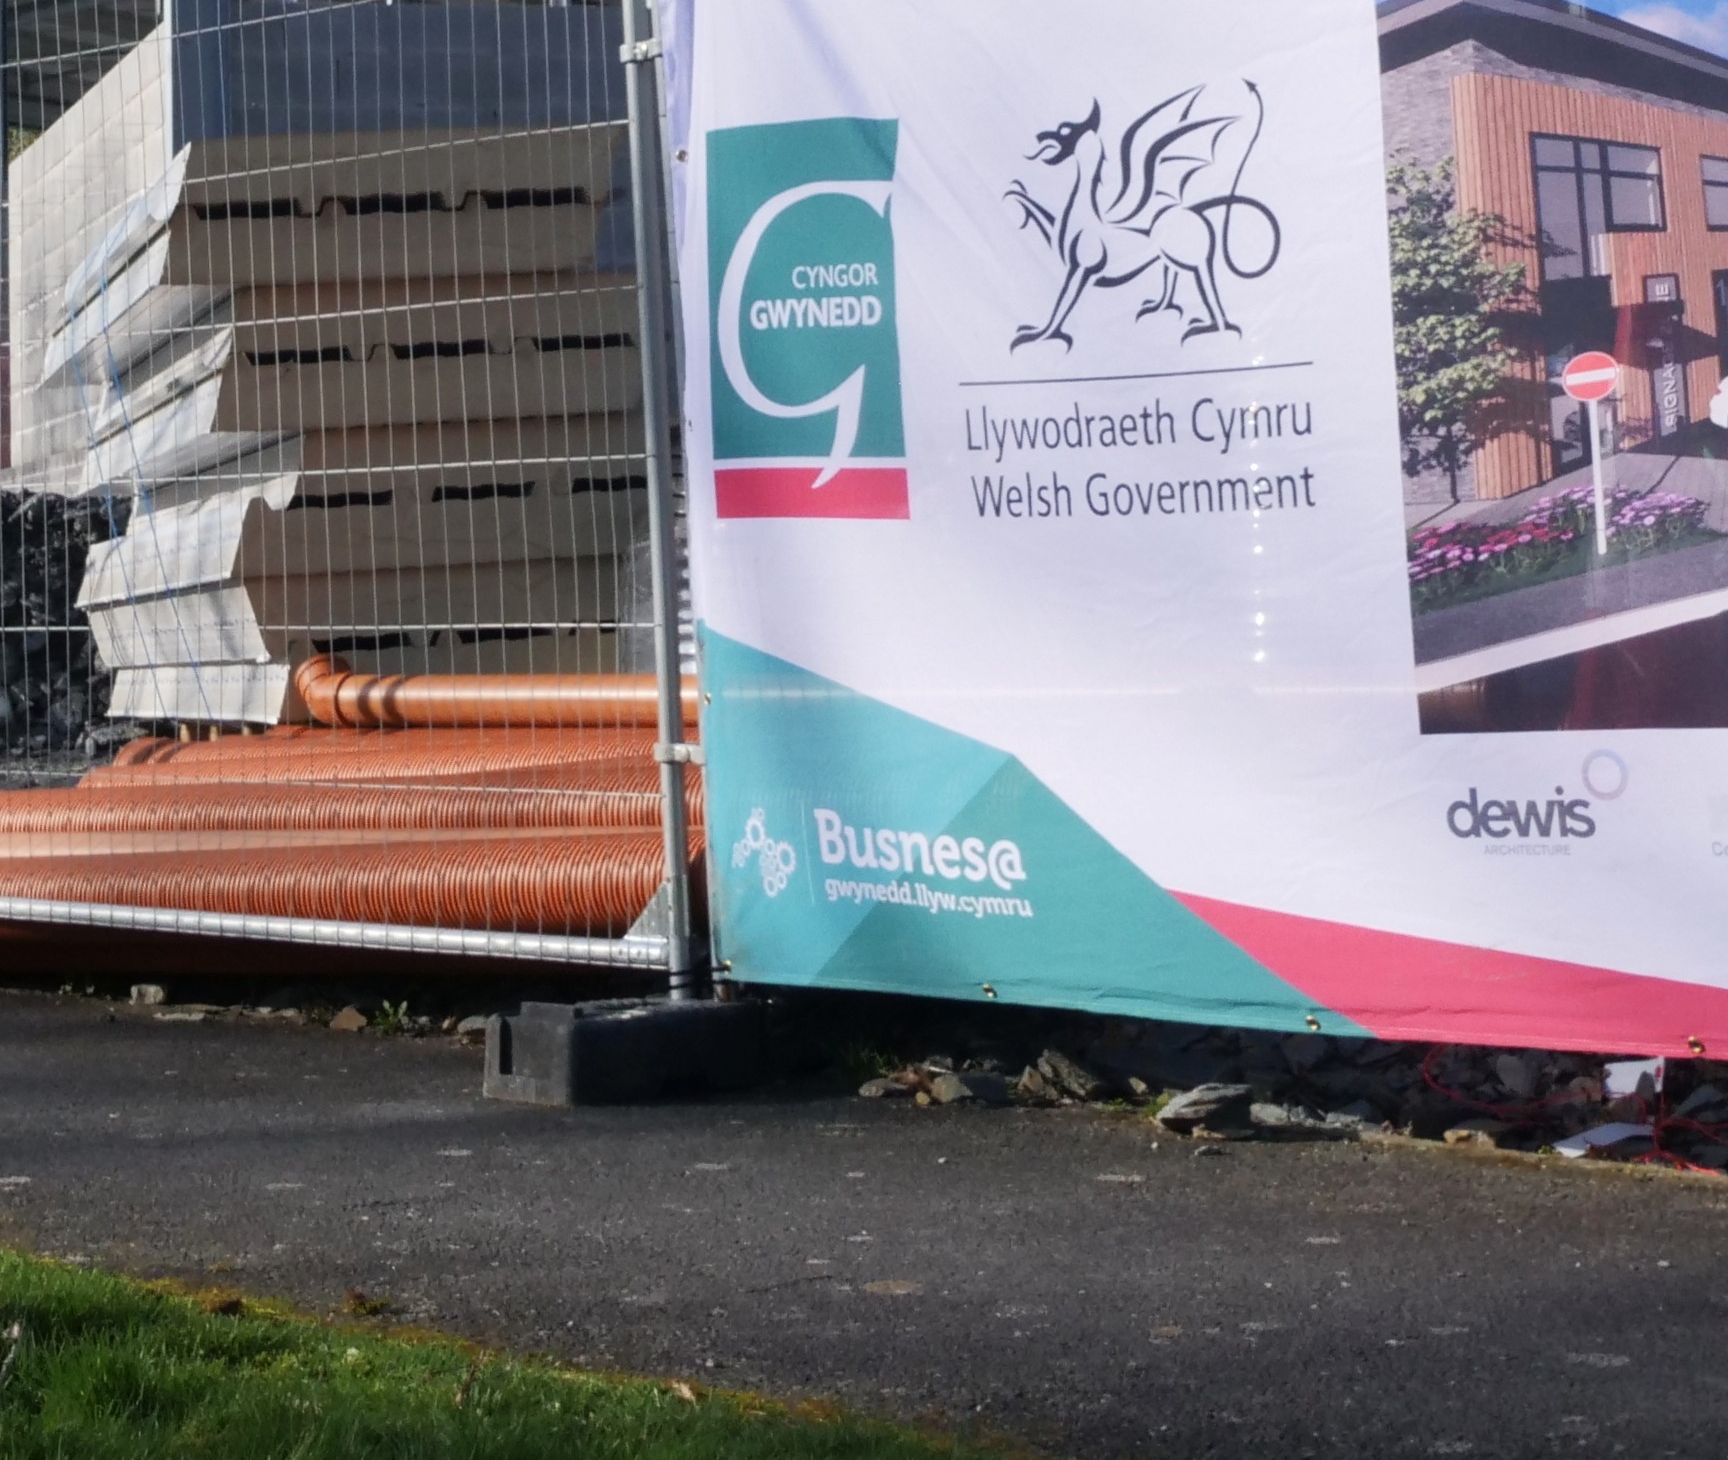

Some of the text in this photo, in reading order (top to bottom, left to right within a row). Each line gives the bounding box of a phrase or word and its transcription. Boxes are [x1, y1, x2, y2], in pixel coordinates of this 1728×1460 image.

[791, 263, 878, 289] CYNGOR
[750, 297, 882, 329] GWYNEDD
[966, 394, 1313, 462] Llywodraeth Cymru
[971, 465, 1317, 520] Welsh Government
[1447, 785, 1596, 838] dewis
[813, 807, 1027, 890] Busnes@
[1484, 844, 1571, 856] ARCHITECTURE
[825, 877, 1033, 920] gwynedd.llyw.cymru
